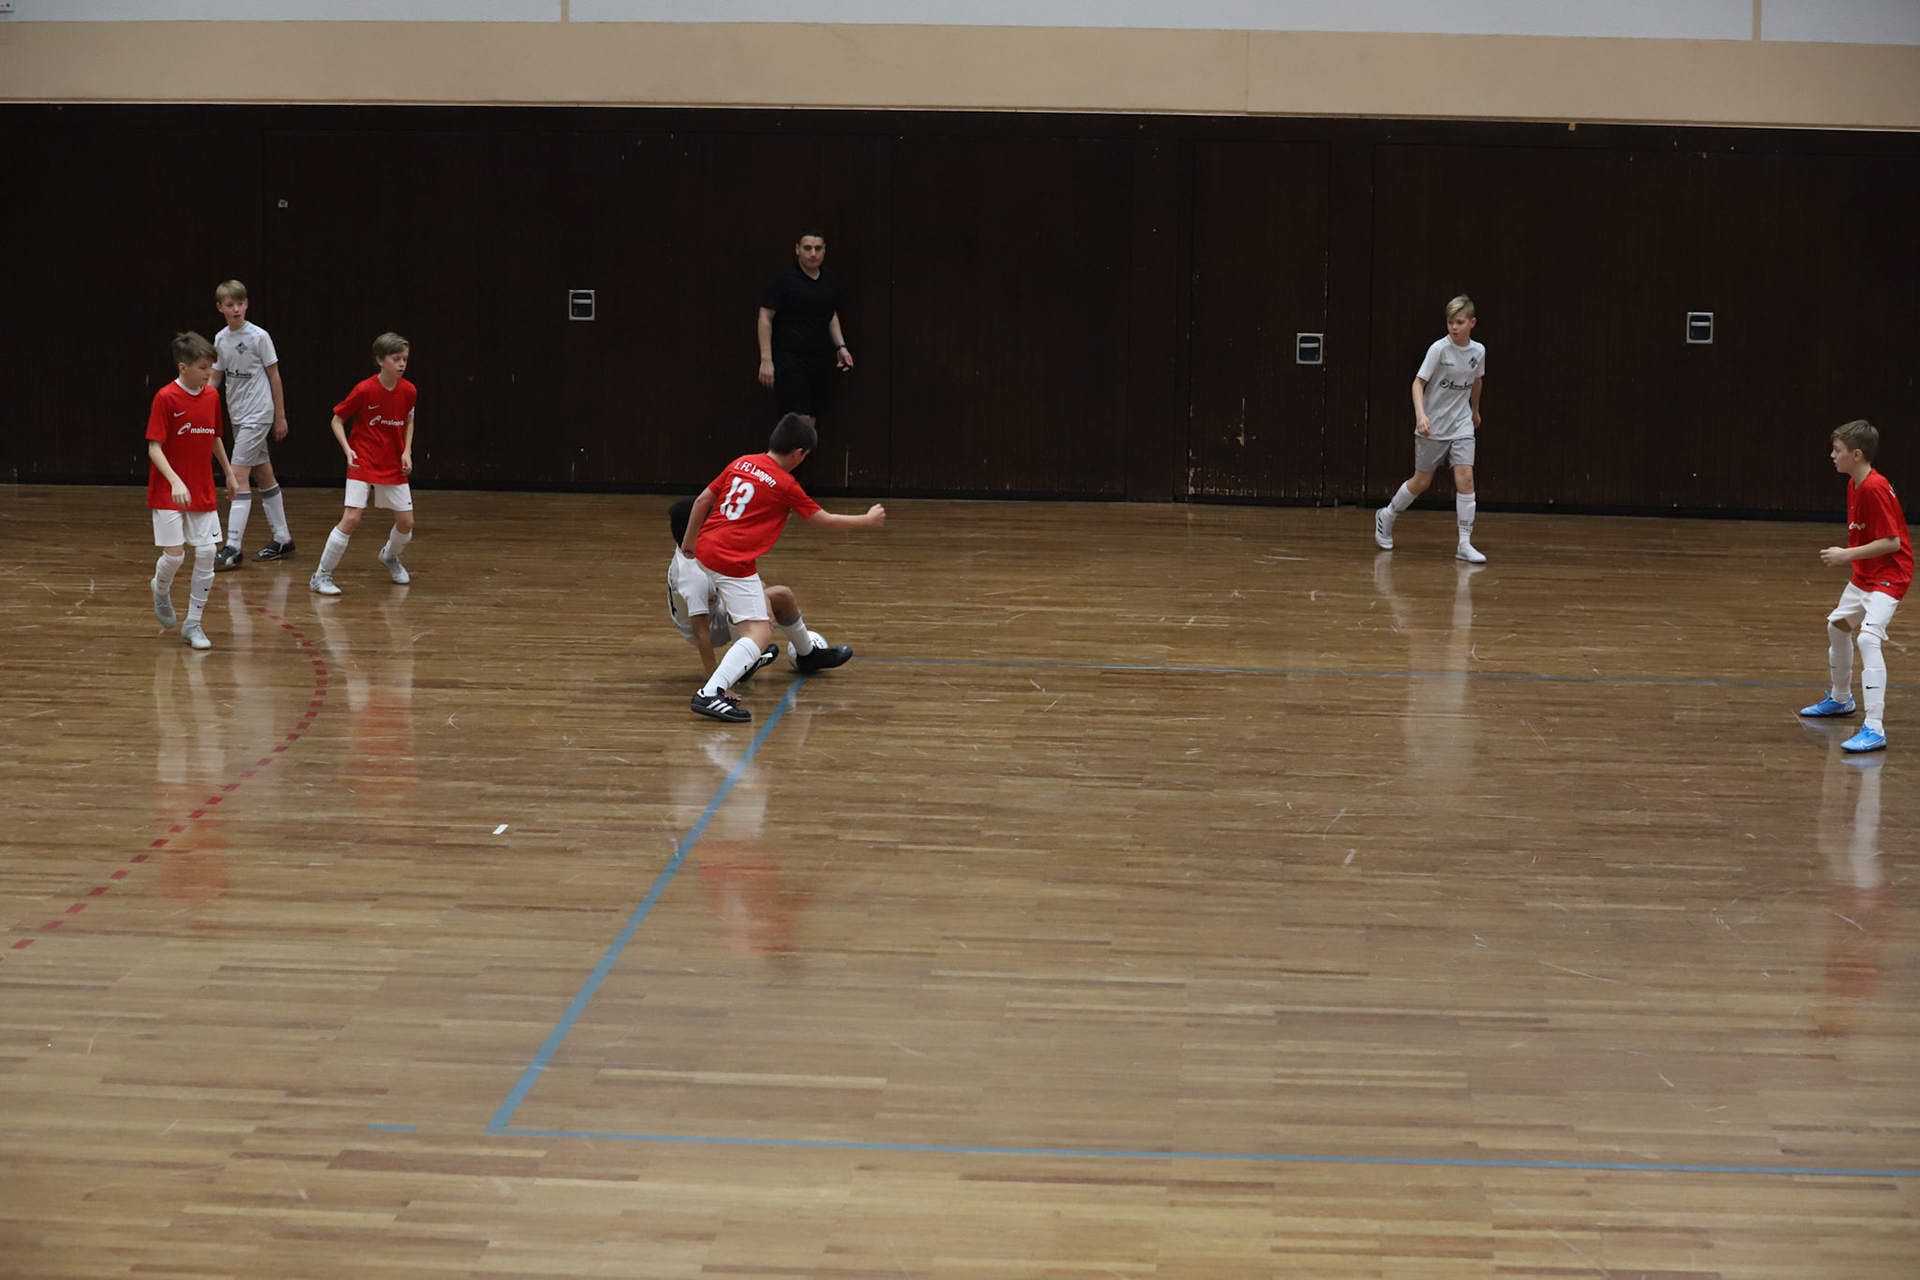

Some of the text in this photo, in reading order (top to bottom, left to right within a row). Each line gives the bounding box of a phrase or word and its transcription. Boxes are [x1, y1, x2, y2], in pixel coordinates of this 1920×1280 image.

[740, 461, 752, 472] FC
[750, 465, 777, 487] Langen
[720, 476, 755, 520] 13
